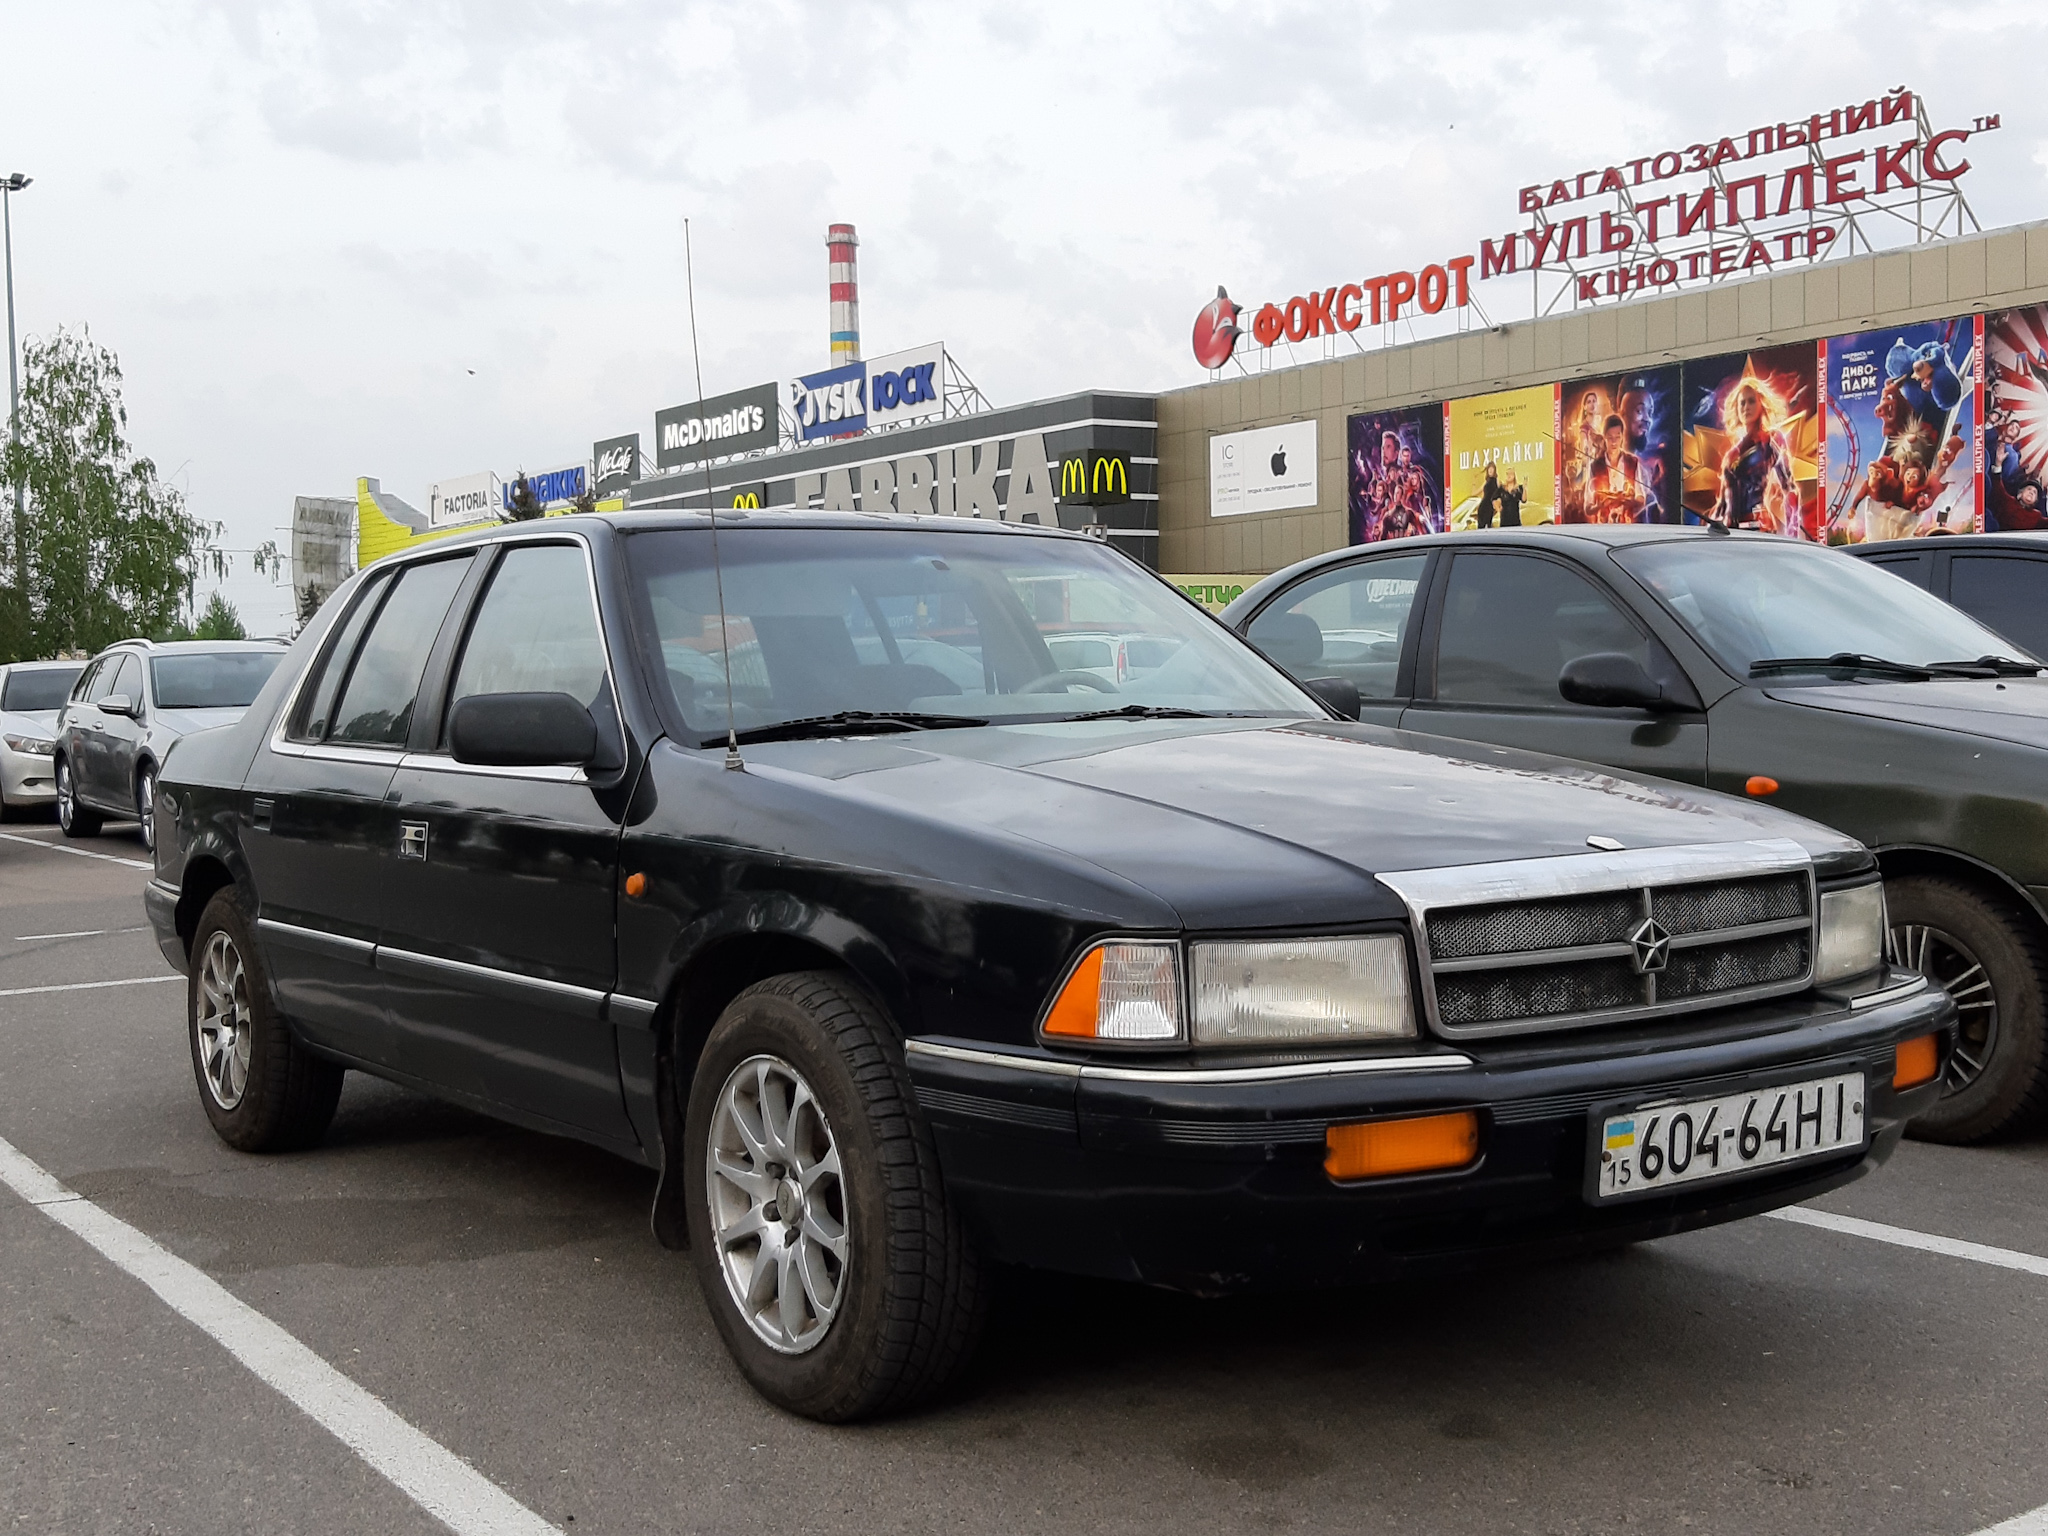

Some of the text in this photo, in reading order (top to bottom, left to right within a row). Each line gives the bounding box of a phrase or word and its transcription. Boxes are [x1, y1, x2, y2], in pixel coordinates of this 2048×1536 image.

[1518, 85, 1914, 213] БАГАТОЗАЛЬНИЙ
[1480, 130, 1972, 280] МУЛЬТИПЛЕКС
[1578, 226, 1836, 300] КІНОТЕАТР
[1253, 256, 1474, 348] ФОКСТРОТ
[1818, 357, 1826, 403] MULTIPLEX
[1841, 363, 1878, 379] ДИВО-
[1974, 334, 1983, 383] MULTIPLEX
[803, 378, 865, 427] JYSK
[1841, 375, 1877, 392] ПАРК
[664, 405, 765, 450] McDonald's
[1975, 424, 1983, 473] MULTIPLEX
[1459, 441, 1544, 470] ШАХРАЙКИ
[1818, 441, 1826, 487] MULTIPLEX
[444, 490, 488, 515] FACTORIA
[795, 434, 1059, 527] FABRIKA
[1607, 1156, 1631, 1187] 15
